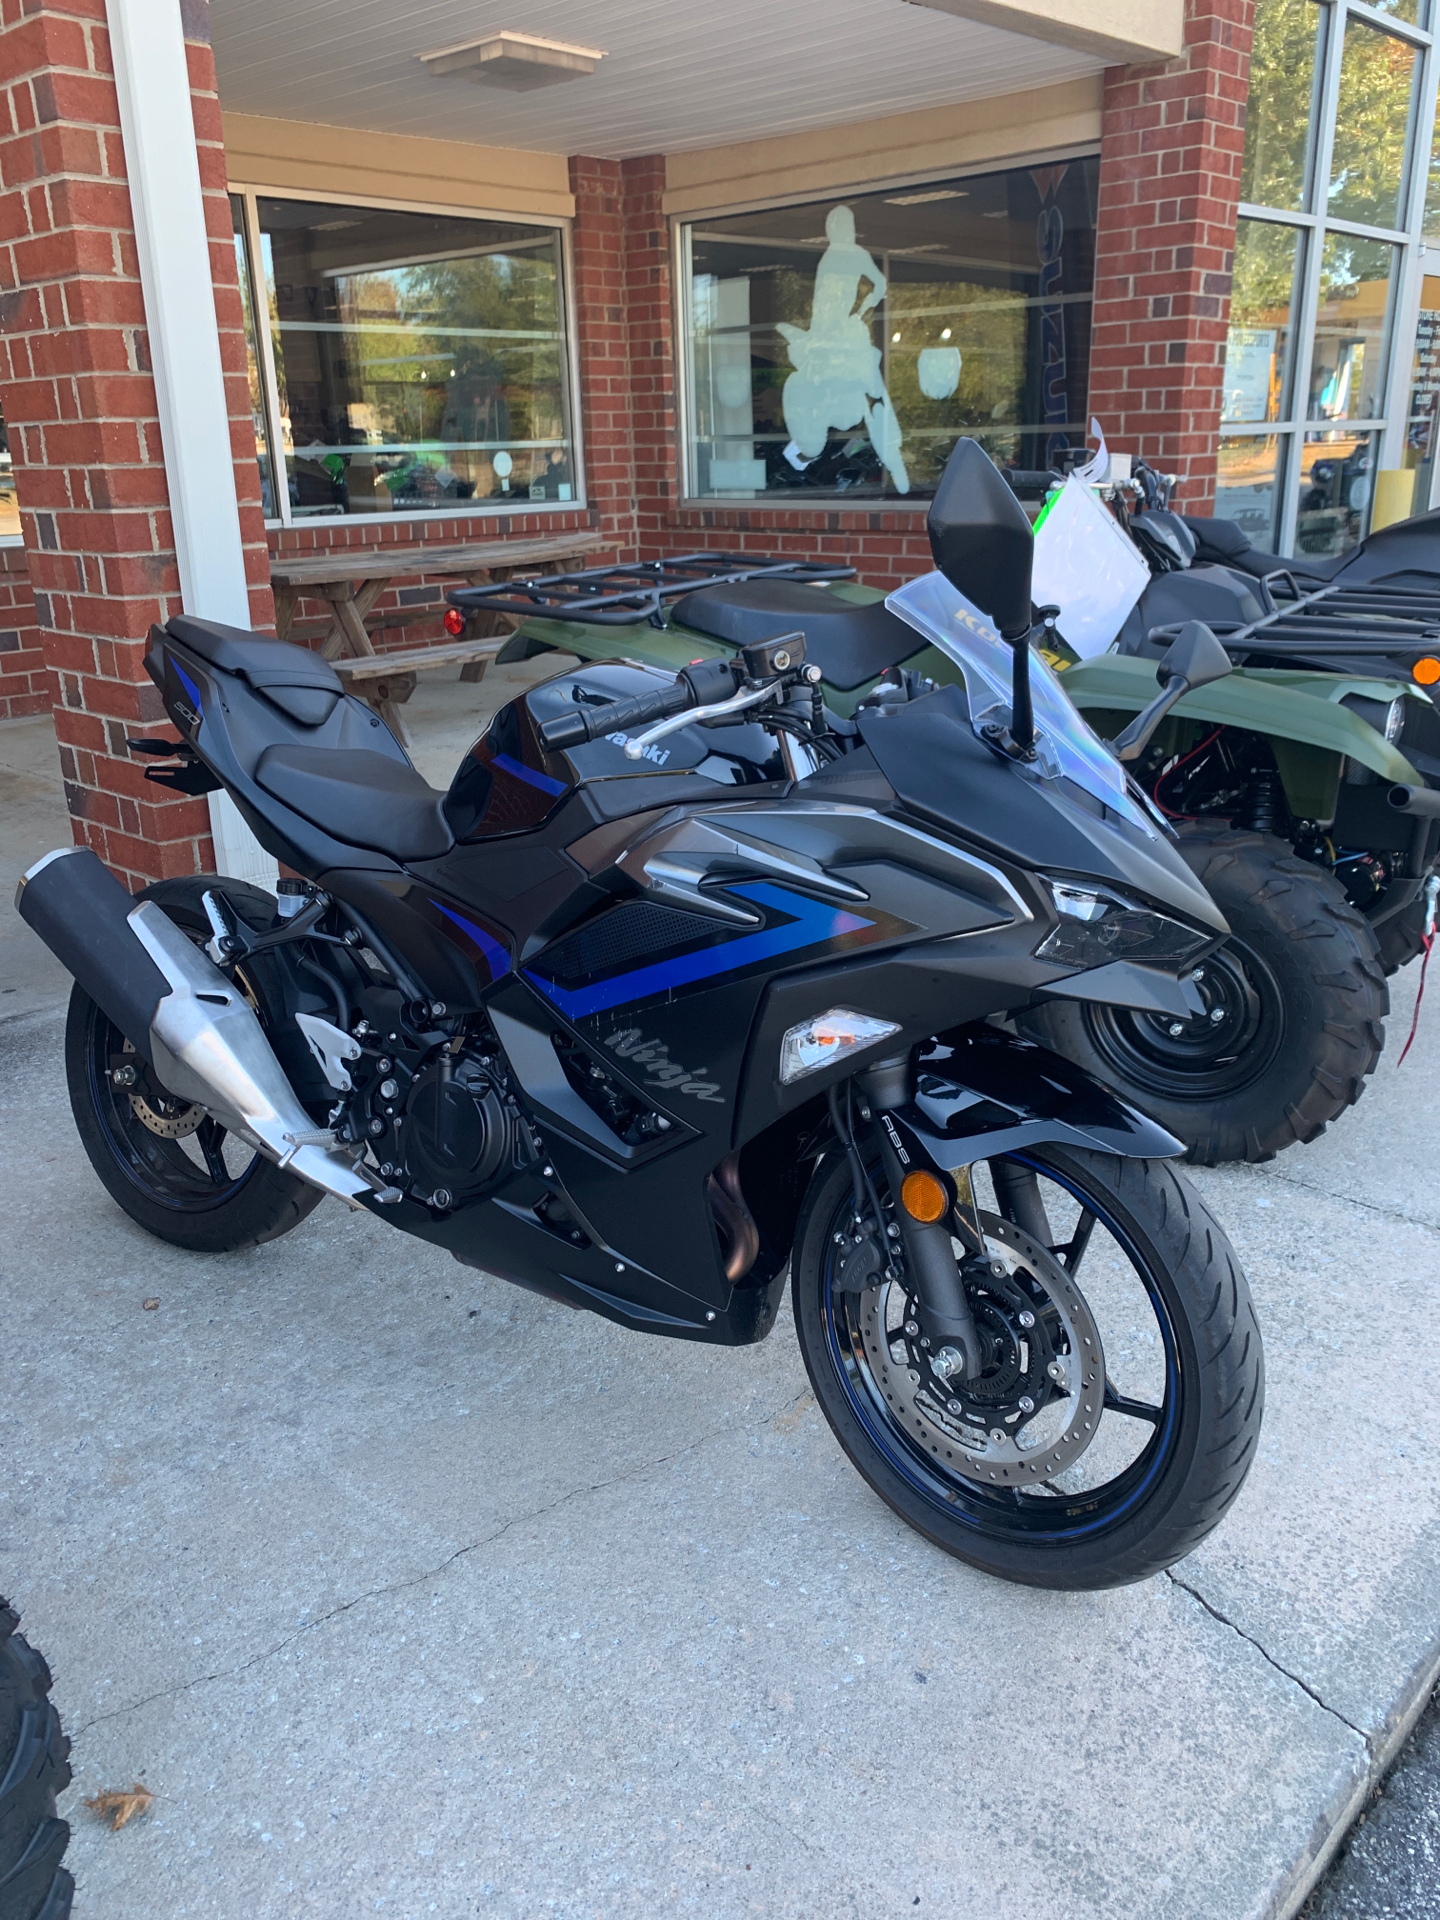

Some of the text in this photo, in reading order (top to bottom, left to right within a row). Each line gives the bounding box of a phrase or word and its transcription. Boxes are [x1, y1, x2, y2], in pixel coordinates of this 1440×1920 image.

[1037, 206, 1070, 469] SUZUK
[173, 701, 201, 725] 500
[603, 1028, 726, 1103] Ninja
[881, 1114, 911, 1165] ABS
